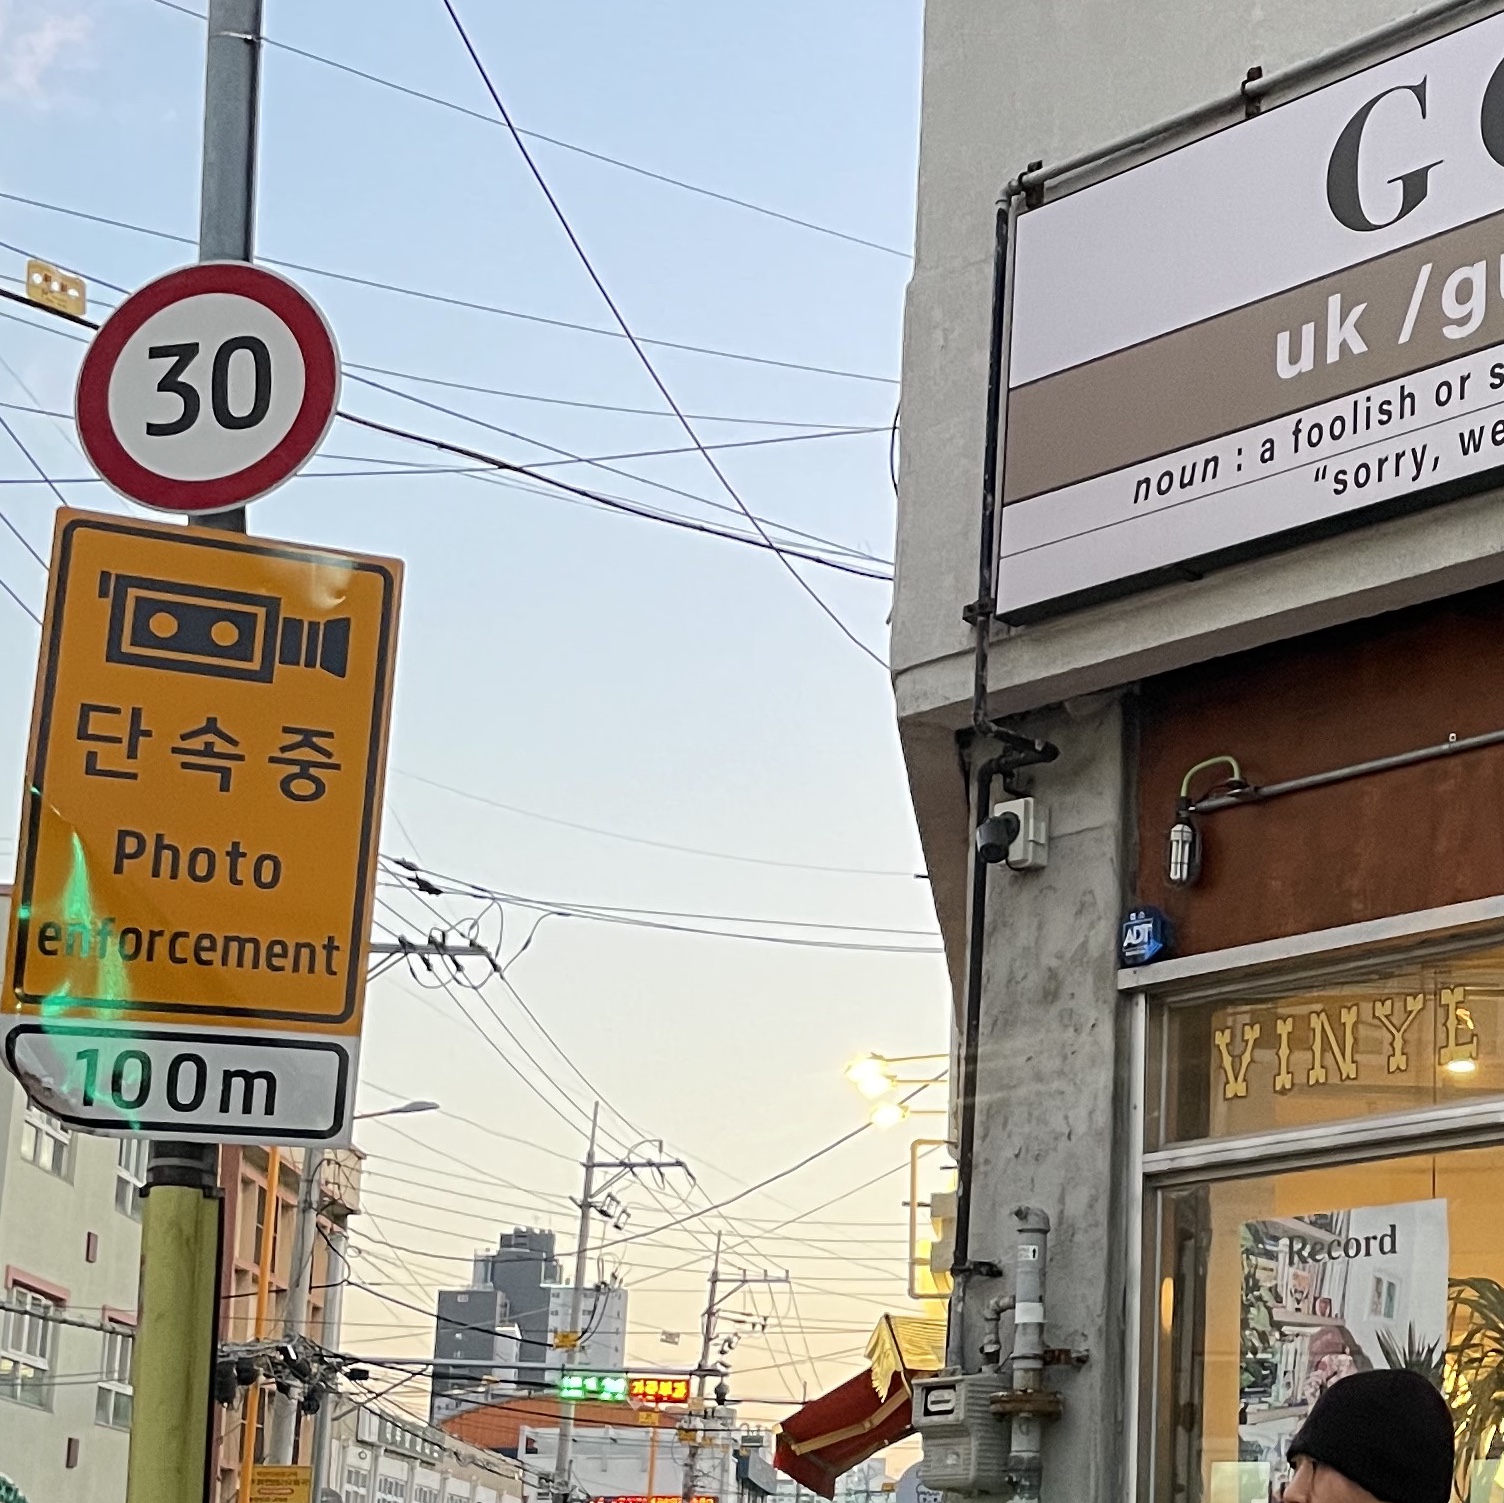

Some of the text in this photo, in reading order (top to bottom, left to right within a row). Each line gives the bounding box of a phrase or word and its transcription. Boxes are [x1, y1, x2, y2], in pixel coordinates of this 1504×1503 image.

[1275, 293, 1369, 380] uk
[145, 335, 272, 437] 30
[1133, 451, 1220, 505] noun
[1259, 437, 1276, 465] a
[1291, 384, 1416, 455] foolish
[1435, 370, 1473, 407] or
[112, 829, 282, 890] Photo
[38, 916, 341, 976] enforcement
[1123, 923, 1153, 947] ADT
[73, 1047, 278, 1117] 100m
[1287, 1223, 1398, 1265] Record
